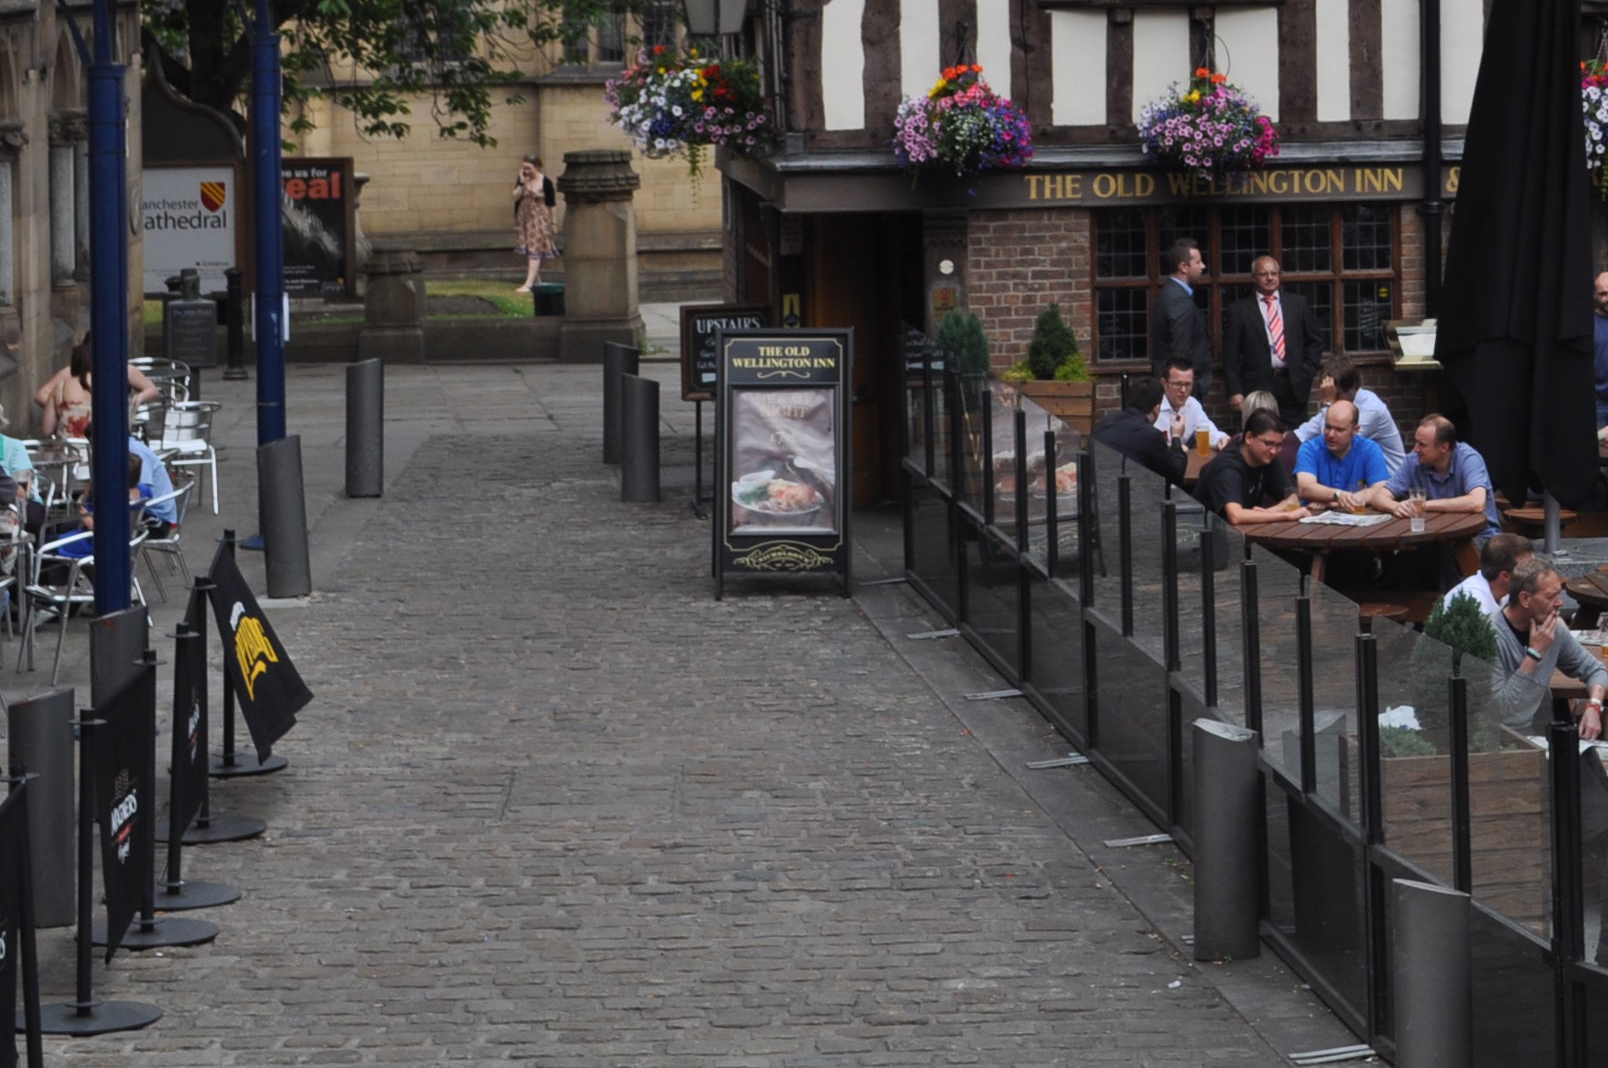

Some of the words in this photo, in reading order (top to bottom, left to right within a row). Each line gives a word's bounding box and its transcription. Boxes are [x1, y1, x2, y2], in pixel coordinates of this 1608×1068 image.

[311, 168, 328, 178] for
[286, 172, 341, 199] eal
[1024, 174, 1081, 200] THE
[1093, 172, 1155, 198] OLD
[1355, 168, 1403, 193] INN
[142, 198, 198, 211] anchester
[144, 210, 227, 230] athedral
[758, 346, 784, 357] THE
[785, 346, 810, 357] OLD
[732, 358, 812, 369] WELLINGTON
[814, 358, 835, 368] INN
